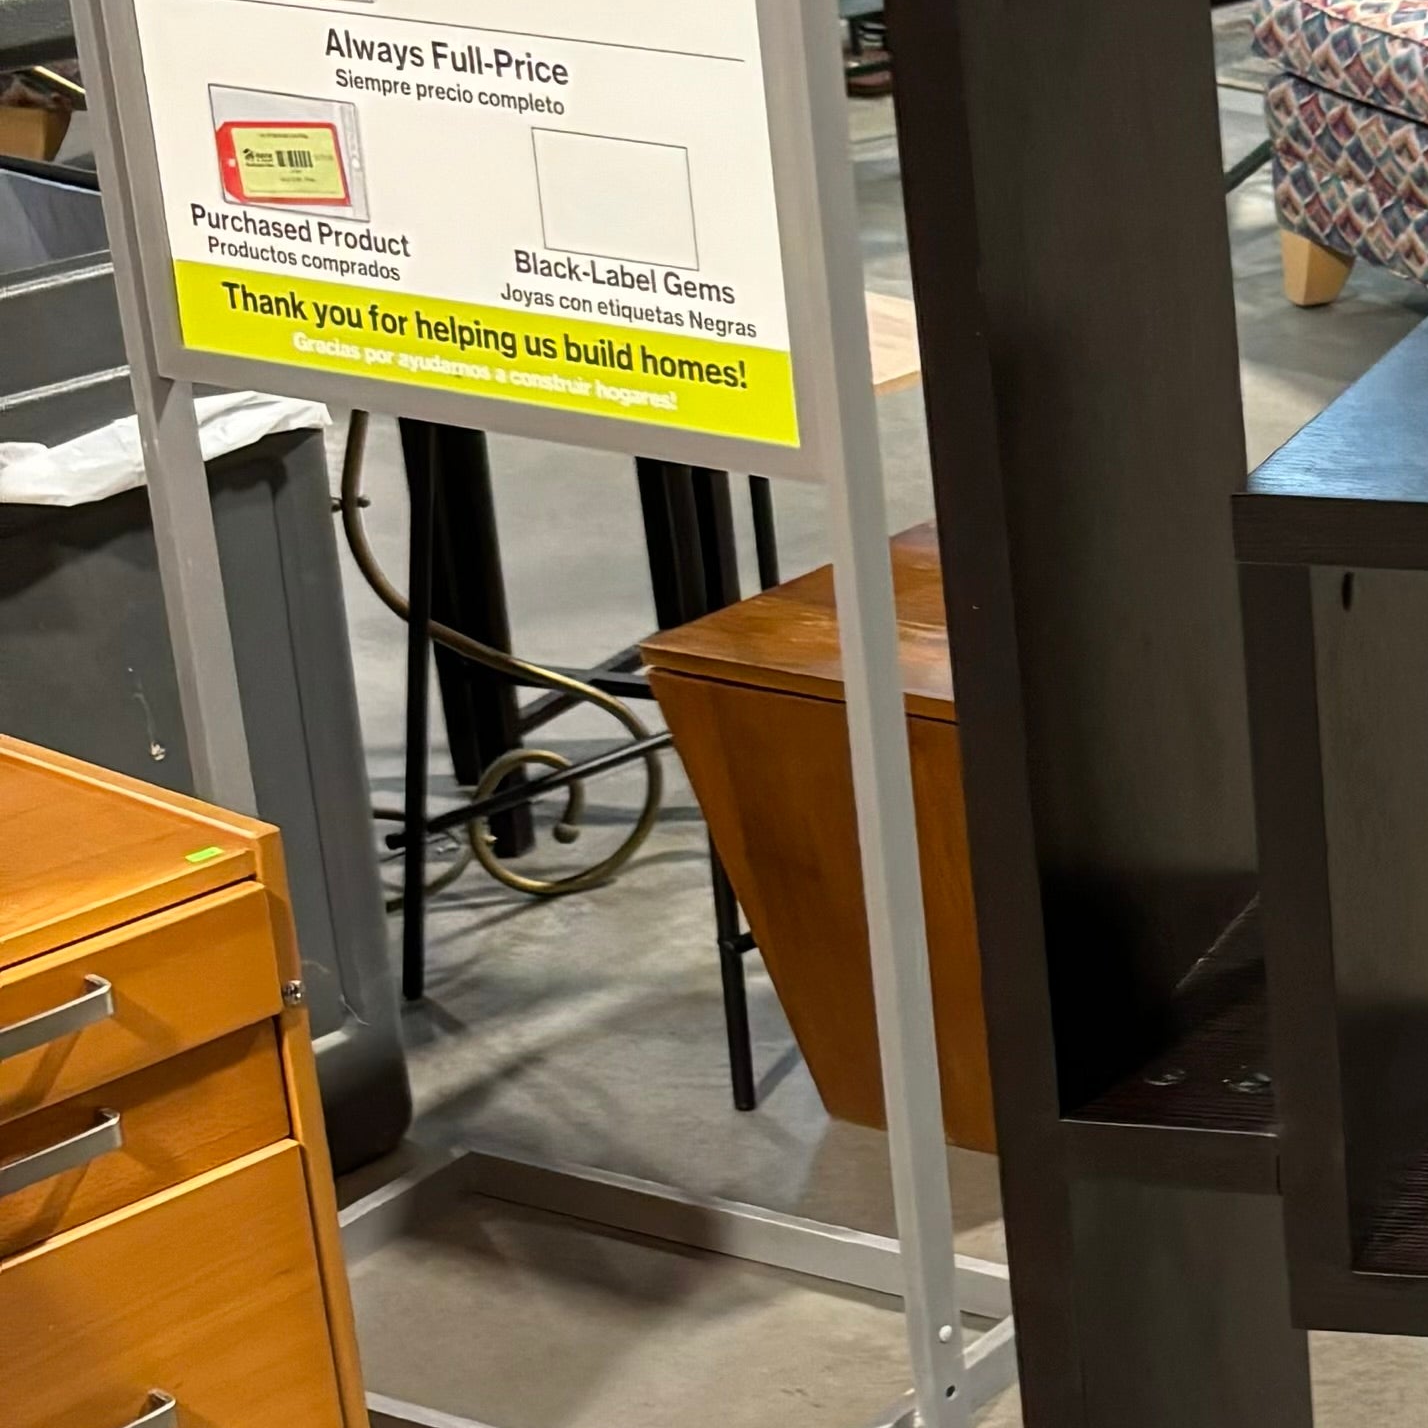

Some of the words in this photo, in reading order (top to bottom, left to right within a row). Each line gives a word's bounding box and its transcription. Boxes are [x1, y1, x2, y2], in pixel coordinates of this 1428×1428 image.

[325, 28, 425, 71] Always
[431, 40, 570, 86] Full-Price
[335, 68, 411, 102] Siempre
[416, 82, 473, 106] precio
[478, 88, 566, 116] completo
[190, 203, 313, 243] Purchased
[317, 221, 412, 258] Product
[208, 235, 298, 267] Productos
[301, 252, 401, 282] comprados
[514, 249, 657, 294] Black-Label
[663, 270, 736, 305] Gems
[221, 281, 308, 321] Thank
[312, 300, 364, 330] you
[367, 303, 409, 336] for
[414, 310, 518, 360] helping
[523, 333, 558, 360] us
[563, 333, 634, 372] build
[640, 343, 748, 390] homes!
[500, 282, 555, 309] Joyas
[558, 294, 593, 314] con
[597, 298, 685, 328] etiquetas
[688, 309, 758, 339] Negras
[292, 331, 362, 361] Gracias
[364, 346, 395, 366] por
[494, 368, 508, 385] a
[509, 370, 594, 398] construir
